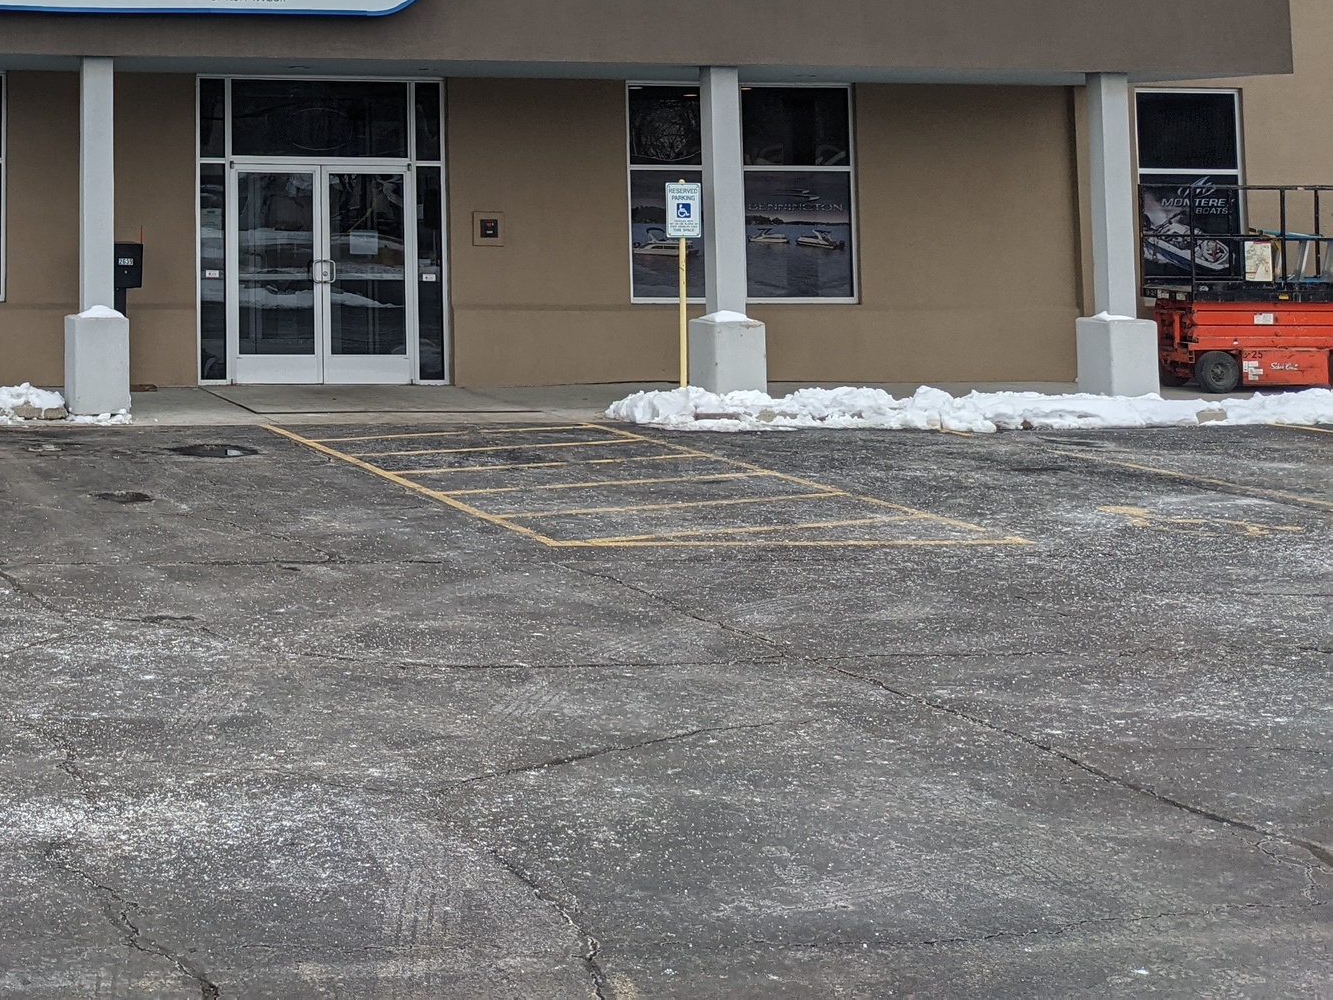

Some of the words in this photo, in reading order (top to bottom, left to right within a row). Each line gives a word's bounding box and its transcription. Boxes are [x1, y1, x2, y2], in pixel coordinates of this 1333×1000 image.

[748, 202, 844, 212] BENNINGTON
[1161, 198, 1235, 207] MONTERE
[1195, 207, 1228, 215] BOATS
